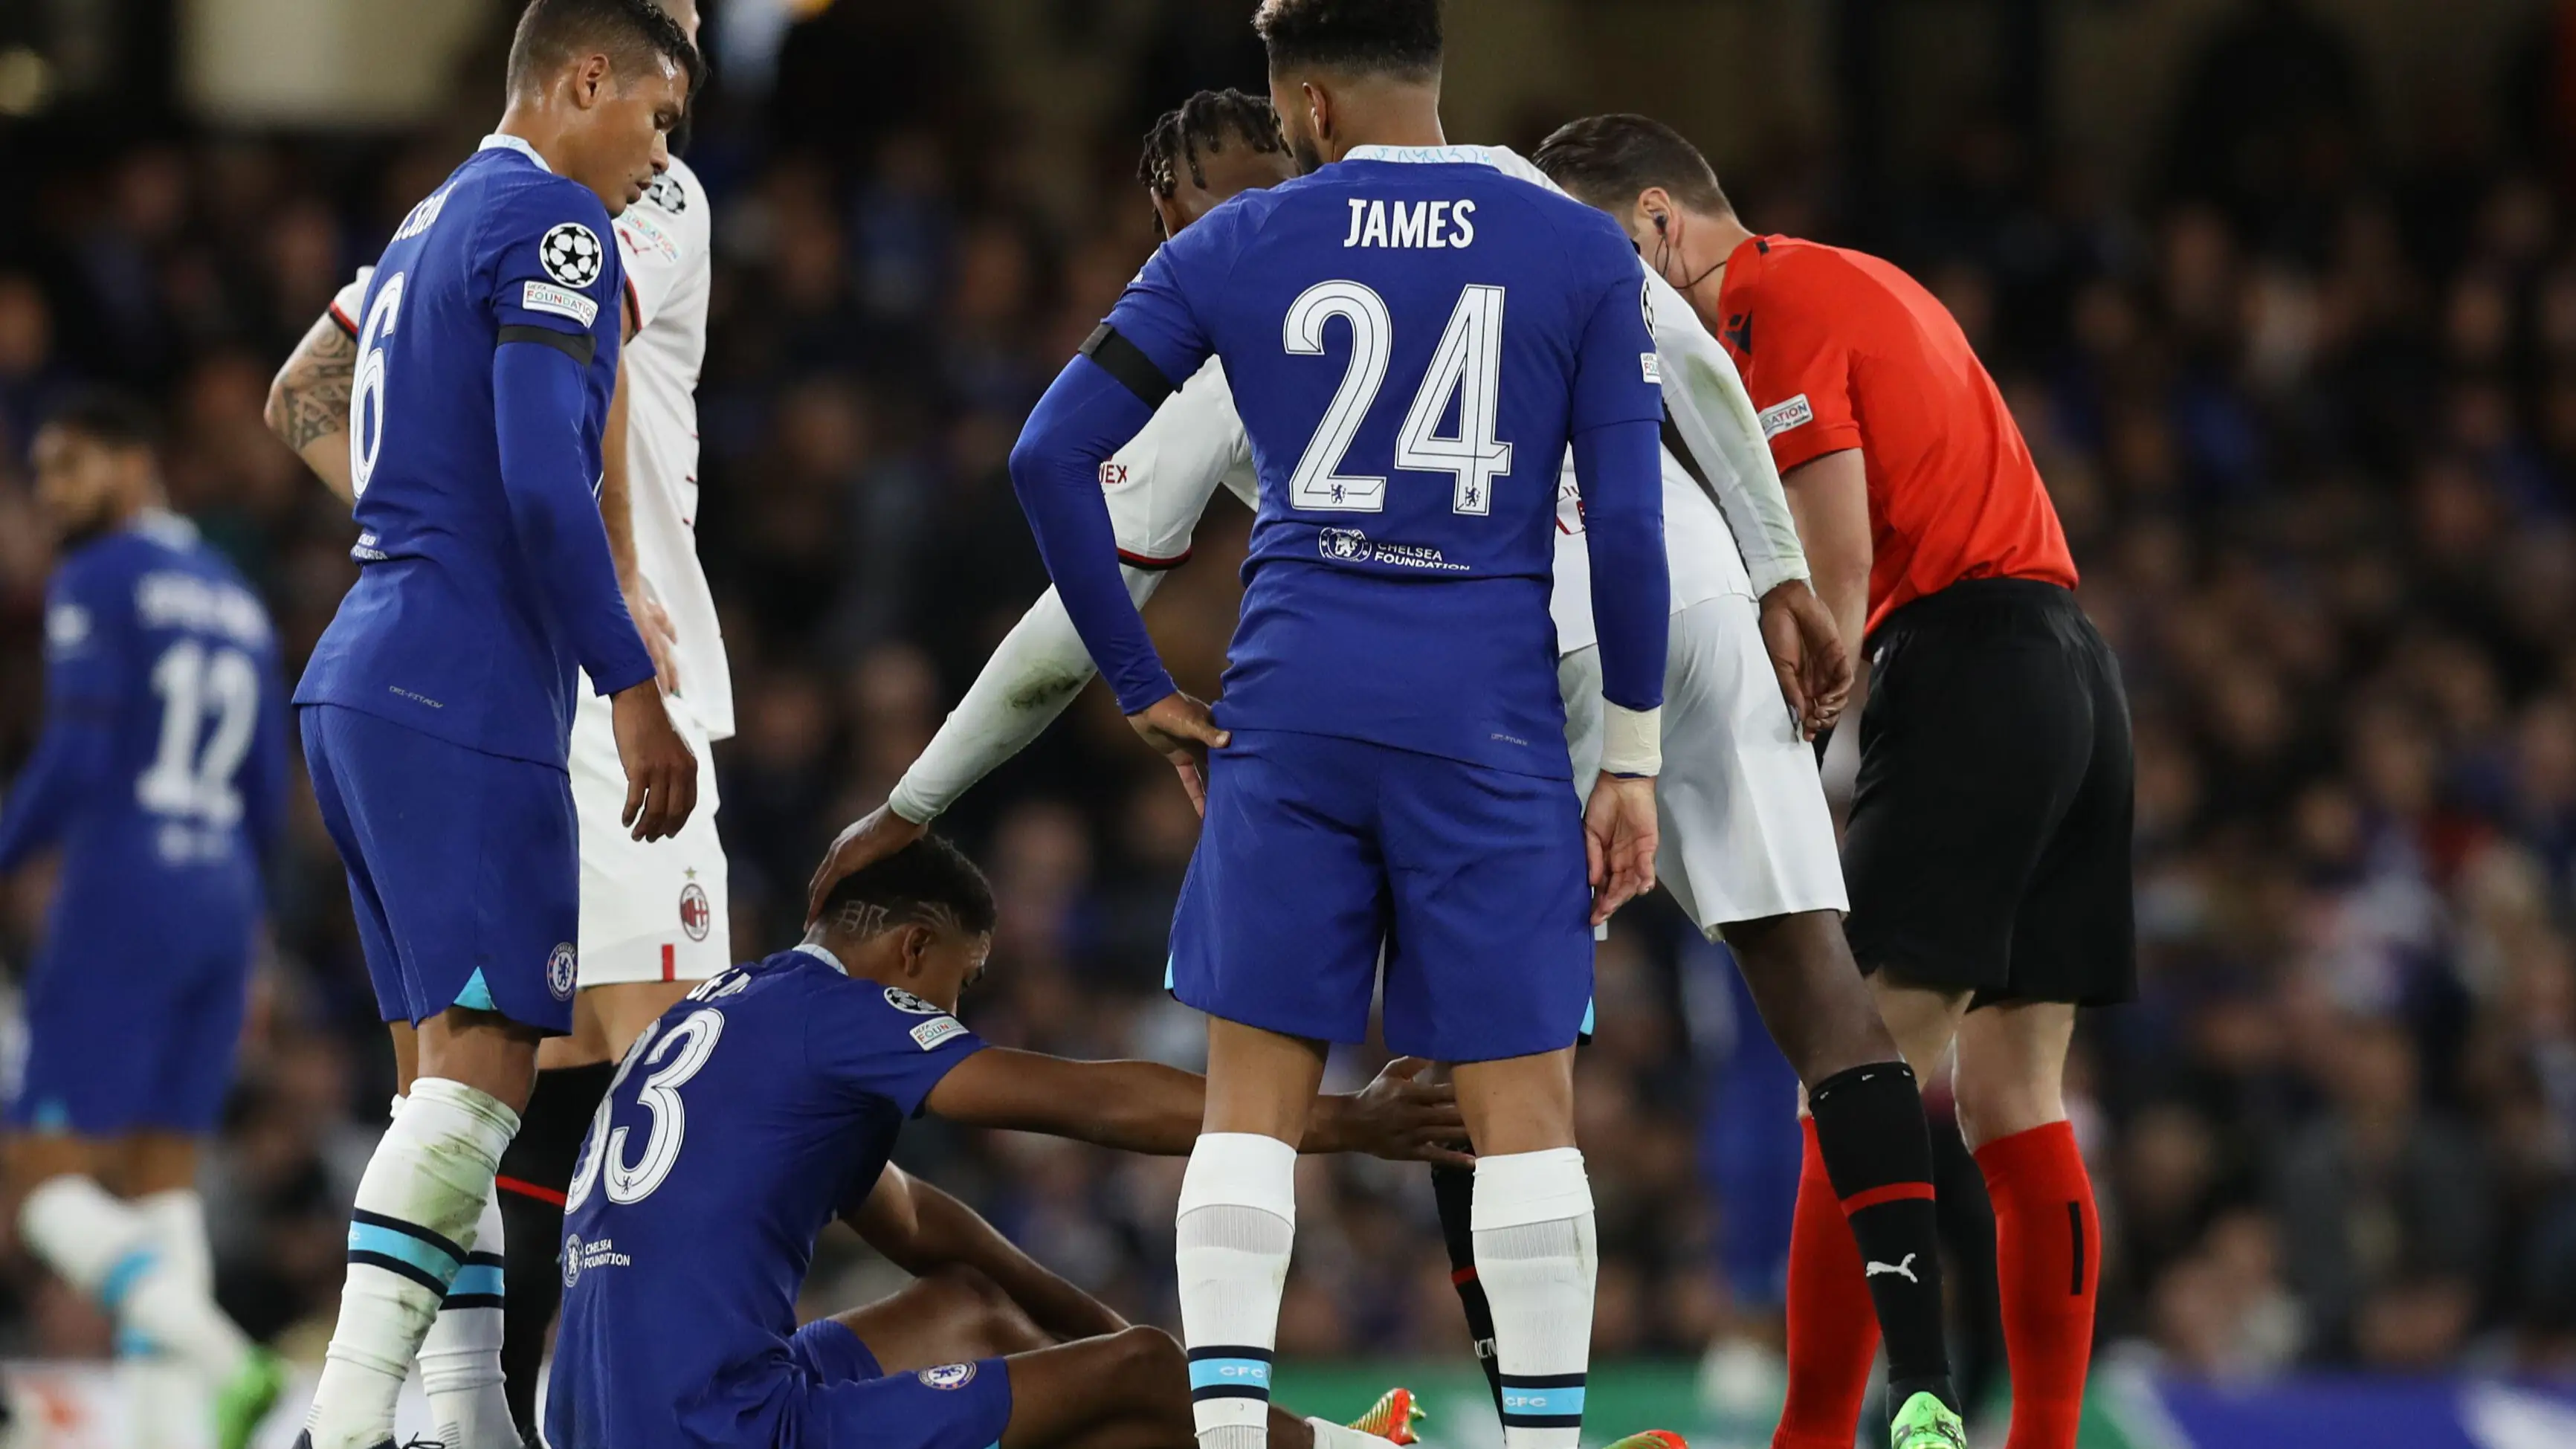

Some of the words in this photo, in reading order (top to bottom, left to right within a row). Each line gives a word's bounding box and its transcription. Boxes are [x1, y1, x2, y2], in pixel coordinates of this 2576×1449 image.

[1343, 199, 1475, 248] JAMES
[349, 272, 404, 499] 6
[1283, 280, 1512, 516] 24
[1375, 552, 1470, 571] FOUNDATION
[1378, 543, 1442, 561] CHELSEA
[135, 639, 259, 827] 12
[564, 1007, 725, 1215] 33
[585, 1239, 613, 1256] CHELSEA
[1220, 1366, 1264, 1378] CFC
[1505, 1397, 1547, 1407] CFC
